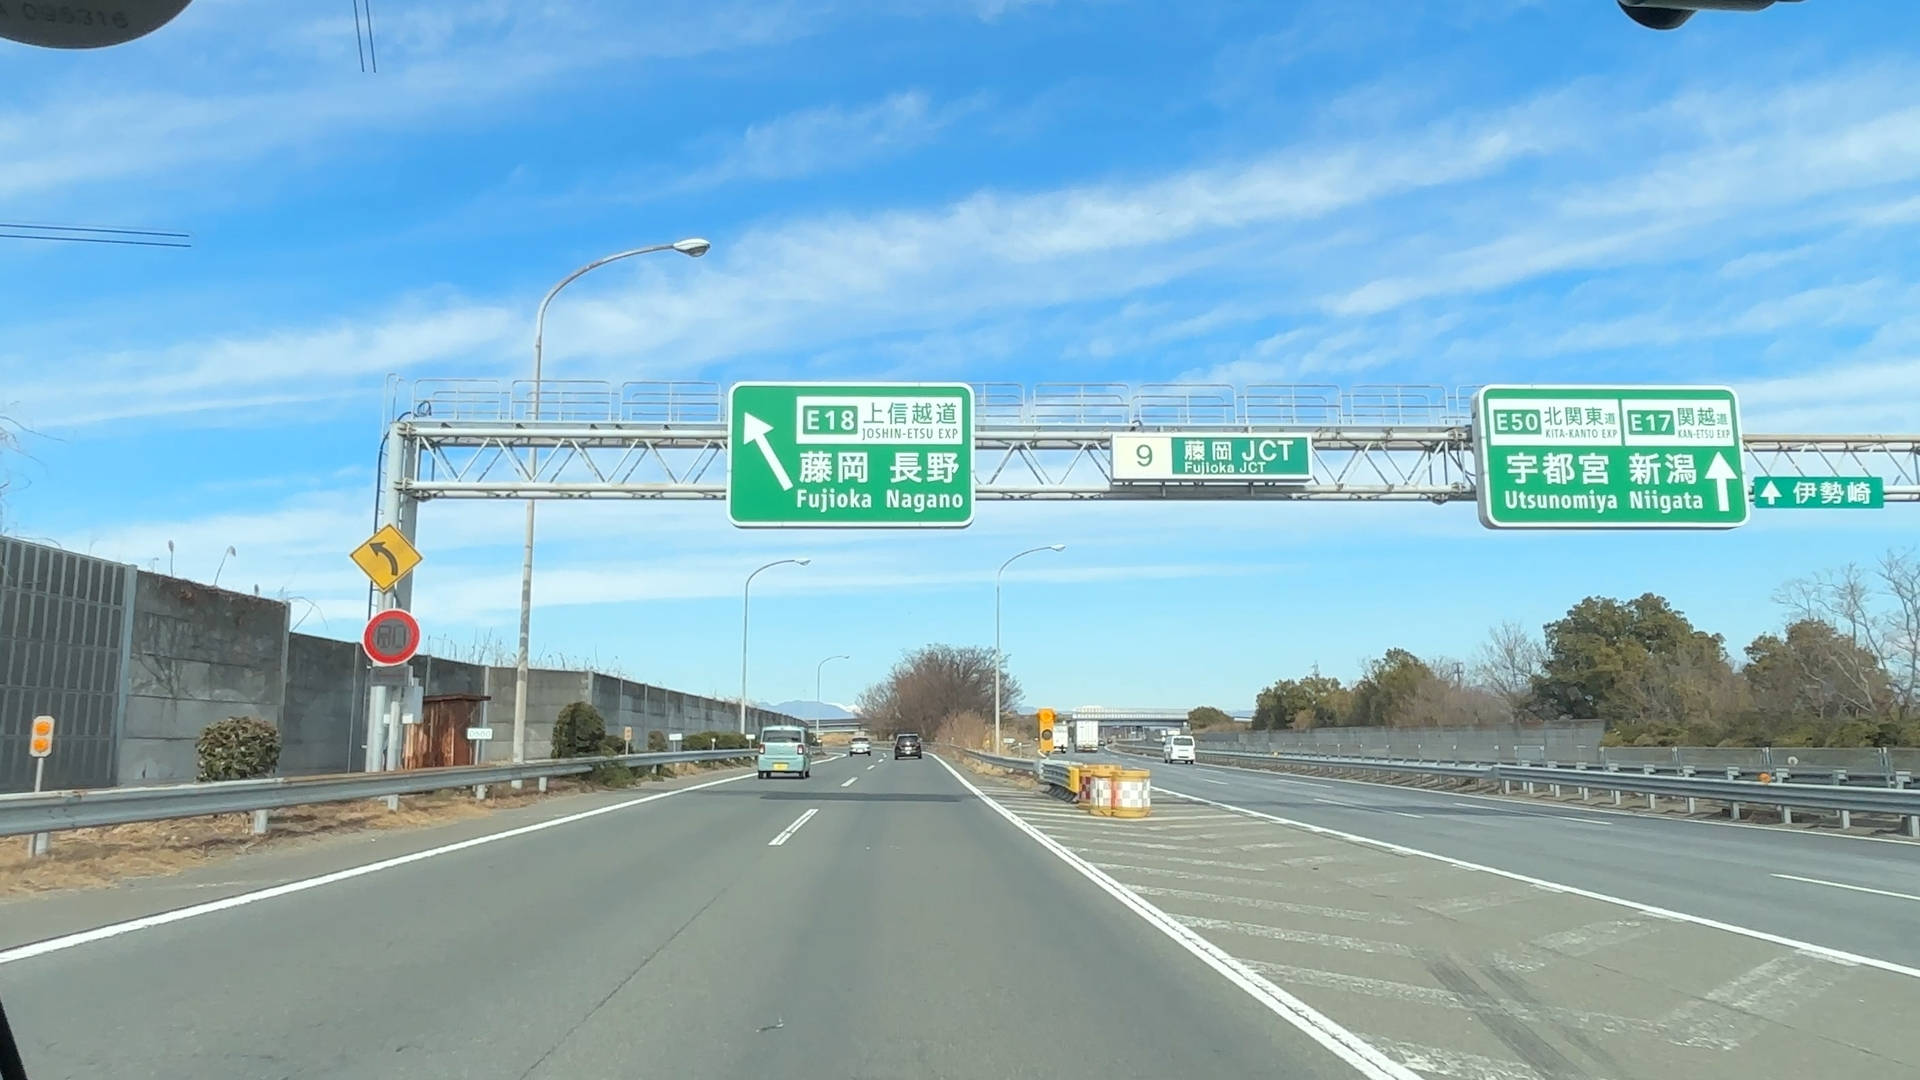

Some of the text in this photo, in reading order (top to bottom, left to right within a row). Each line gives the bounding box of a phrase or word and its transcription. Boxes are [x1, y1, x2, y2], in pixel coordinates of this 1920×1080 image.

[806, 402, 957, 431] E18 上信越道
[1496, 407, 1616, 432] E50 北関東道
[1630, 407, 1729, 432] E17 関越道
[862, 428, 958, 441] JOSHIN-ETSU EXP
[1545, 429, 1618, 439] KITA-KANTO EXP
[1678, 429, 1730, 440] KAN-ETSU EXP
[1136, 444, 1153, 467] 9
[1183, 439, 1294, 462] 藤岡 JCT
[799, 450, 960, 484] 藤岡 長野
[1184, 461, 1267, 476] Fujioka JCT
[1506, 452, 1697, 485] 宇都宮 新潟
[796, 488, 963, 513] Fujioka Nagano
[1504, 490, 1704, 514] Utsunomiya Niigata
[1792, 481, 1872, 505] 伊勢崎
